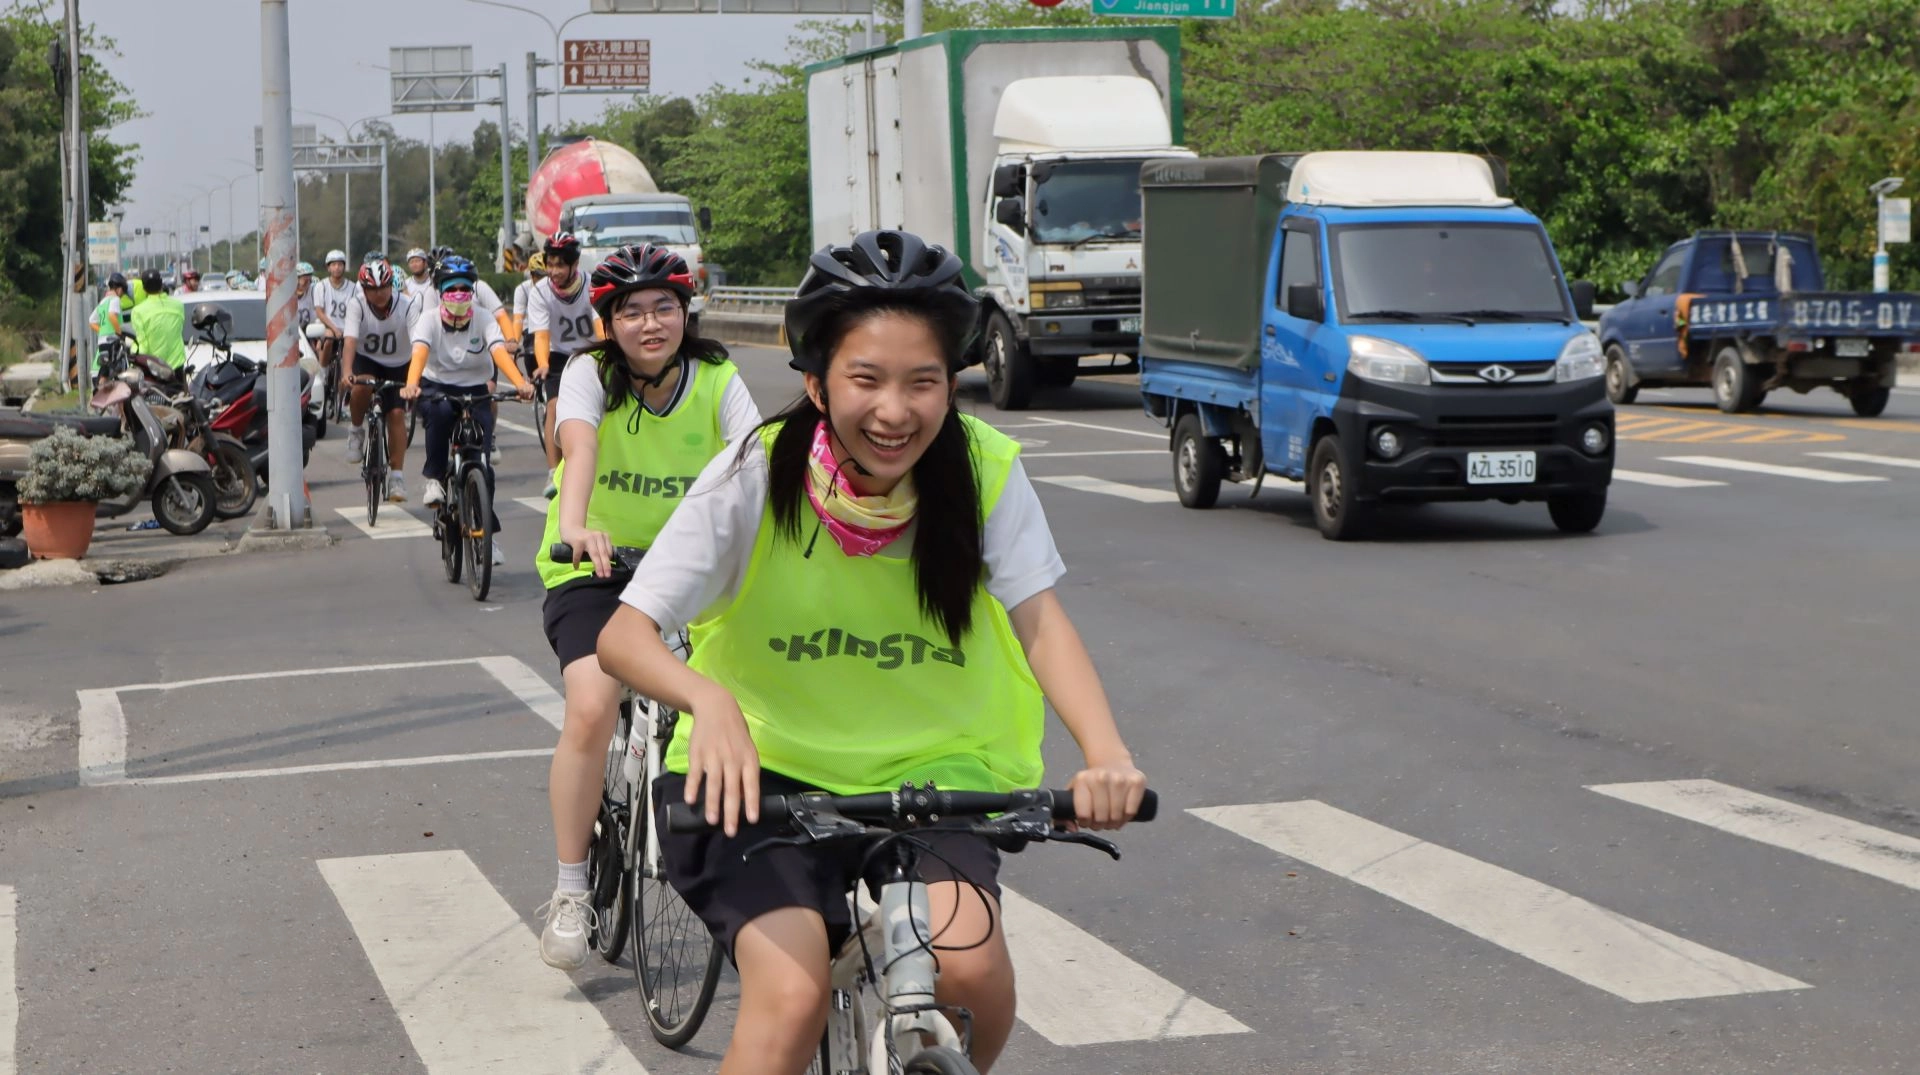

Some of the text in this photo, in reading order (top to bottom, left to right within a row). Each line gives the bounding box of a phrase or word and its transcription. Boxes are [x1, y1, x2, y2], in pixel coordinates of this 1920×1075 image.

[1134, 1, 1190, 13] Jiangjun
[330, 301, 347, 319] 29
[1794, 301, 1912, 329] 8705-DV
[559, 314, 594, 343] 20
[363, 332, 397, 355] 30
[607, 470, 698, 499] KIPST
